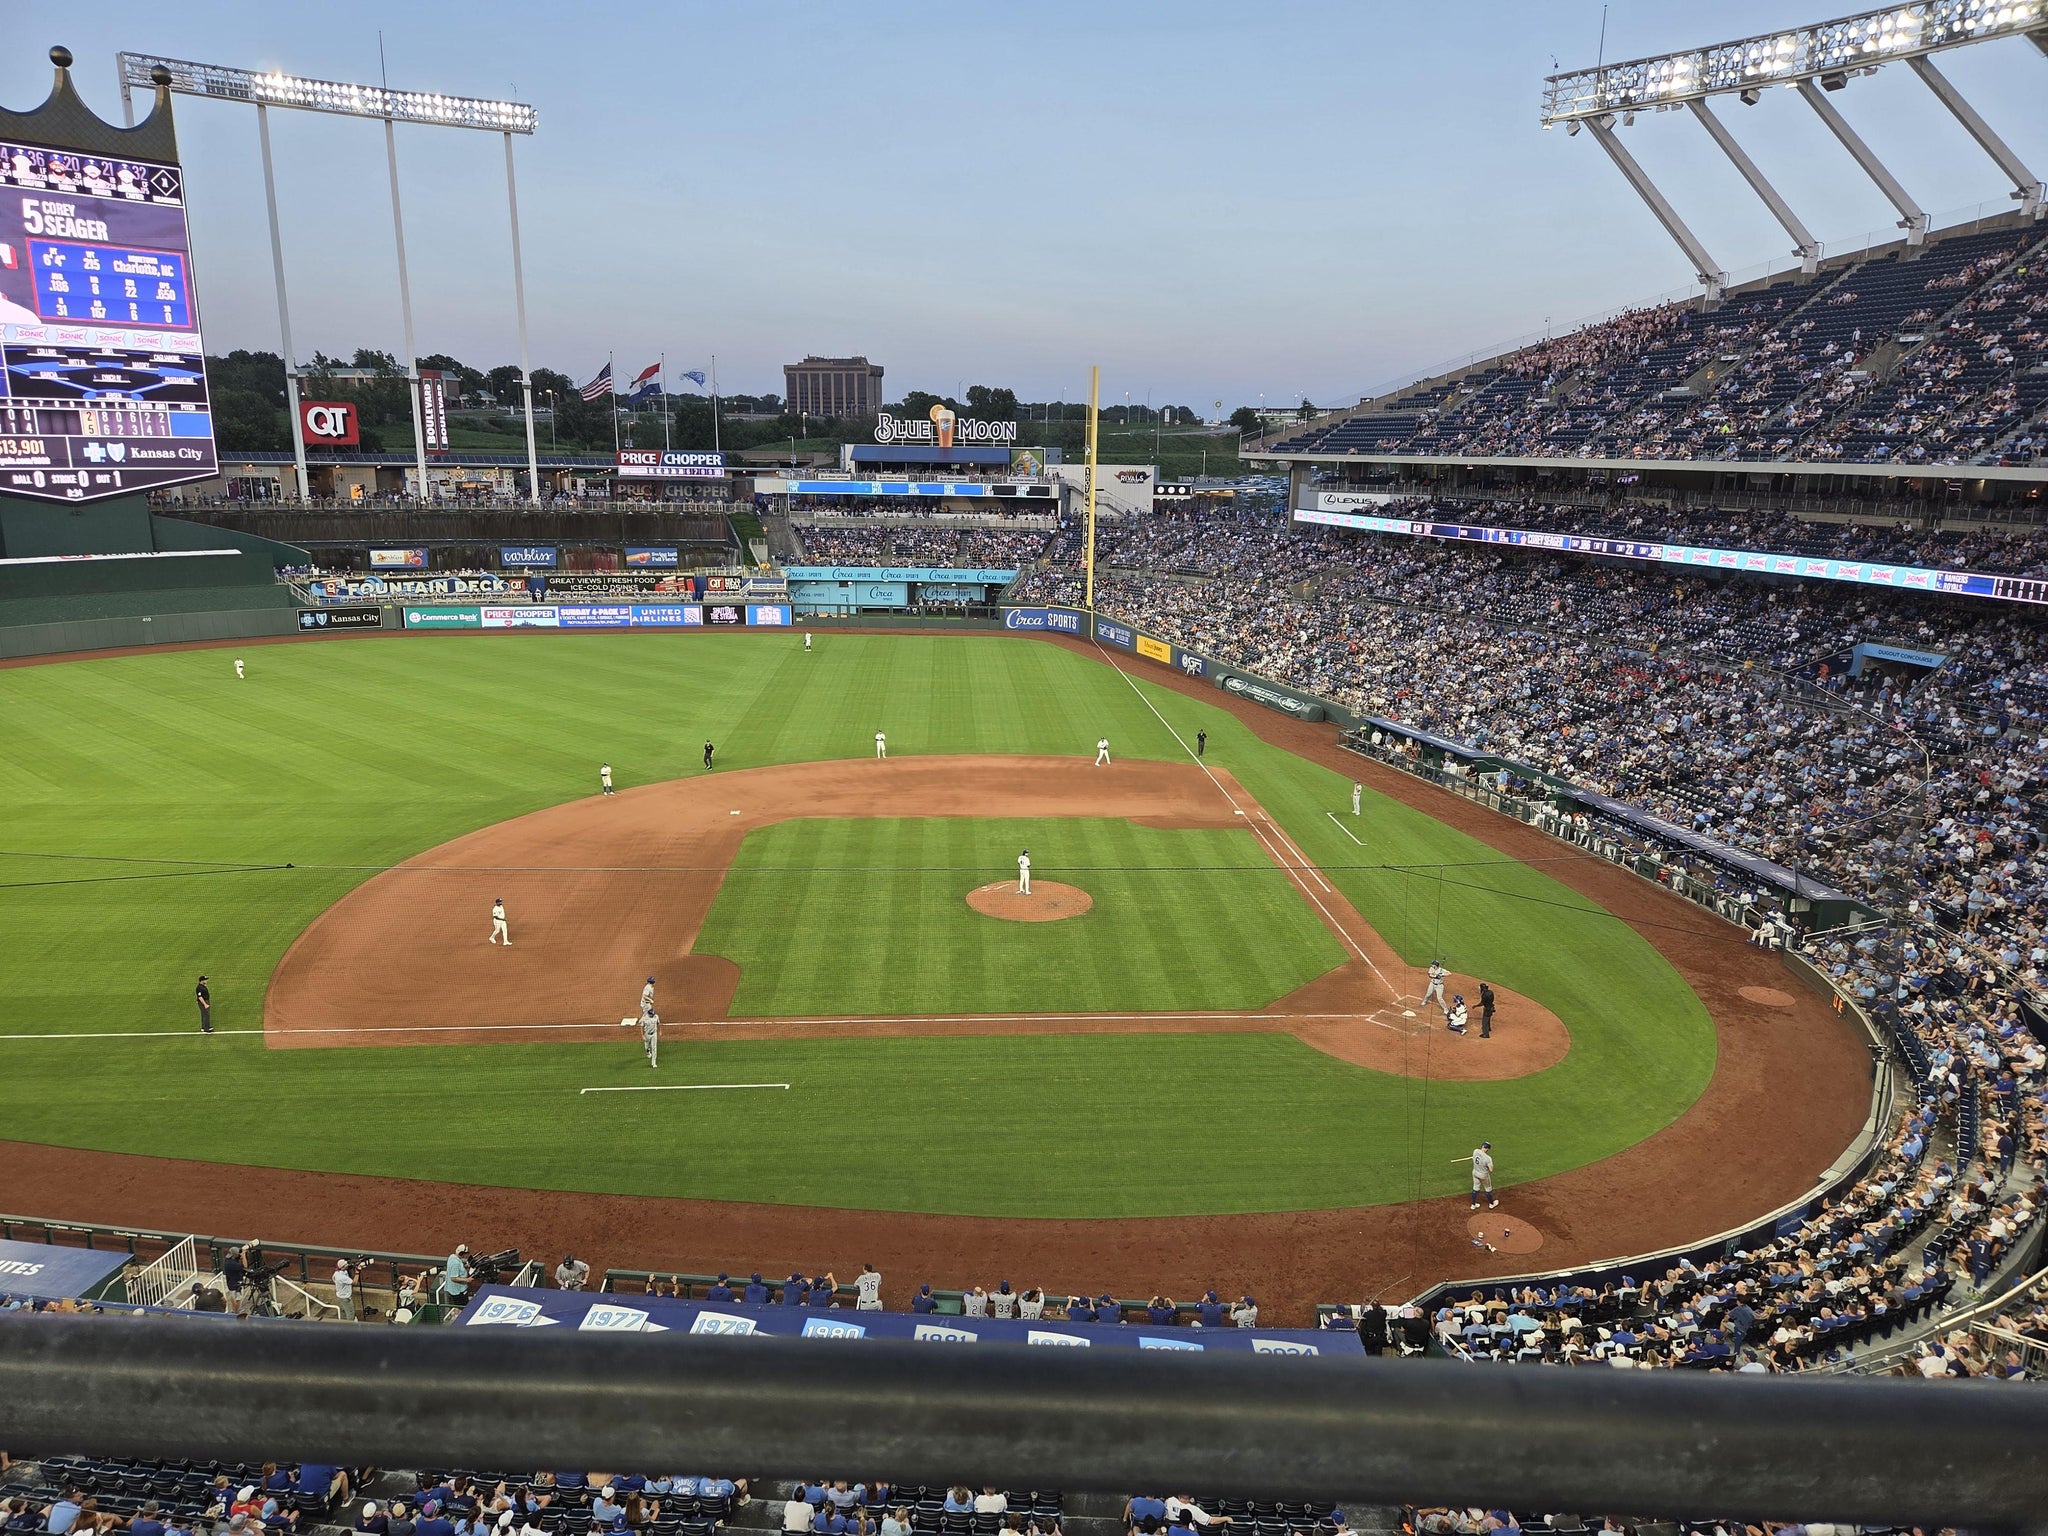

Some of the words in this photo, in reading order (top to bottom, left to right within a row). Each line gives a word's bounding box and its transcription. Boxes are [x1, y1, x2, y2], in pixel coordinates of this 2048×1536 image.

[28, 150, 45, 167] 36
[64, 156, 80, 172] 20
[101, 161, 114, 177] 21
[132, 165, 147, 181] 32
[42, 200, 75, 217] COREY
[22, 198, 44, 234] 5
[43, 214, 109, 241] SEAGER
[113, 260, 160, 277] Charlotte,
[160, 264, 174, 277] NC
[125, 286, 138, 298] 22
[56, 304, 68, 316] 31
[18, 329, 44, 338] SONIC
[59, 332, 84, 341] SONIC
[99, 335, 122, 343] SONIC
[137, 337, 159, 345] SONIC
[173, 339, 195, 347] SONIC
[8, 409, 15, 421] 0
[24, 409, 31, 421] 0
[86, 411, 92, 422] 2
[102, 411, 109, 422] 8
[116, 412, 122, 423] 0
[130, 411, 137, 423] 6
[145, 412, 152, 423] 2
[158, 412, 165, 424] 2
[423, 383, 437, 444] BOULEVARD
[436, 384, 448, 445] BOULEVARD
[306, 405, 348, 438] QT
[10, 423, 16, 434] 1
[25, 423, 33, 434] 4
[88, 424, 95, 434] 5
[103, 424, 110, 435] 6
[117, 424, 124, 436] 2
[131, 425, 138, 436] 3
[146, 425, 153, 436] 4
[160, 425, 166, 436] 1
[874, 413, 931, 443] BLUE
[959, 418, 1017, 441] MOON
[0, 439, 45, 456] 13,901
[131, 447, 176, 459] Kansas
[178, 448, 203, 461] City
[620, 452, 657, 464] PRICE
[663, 453, 722, 466] CHOPPER
[12, 474, 33, 485] BALL
[33, 470, 46, 488] 0
[51, 474, 77, 484] STRIKE
[77, 470, 90, 488] 0
[96, 474, 111, 484] OUT
[113, 470, 122, 487] 1
[1120, 474, 1144, 482] RIVALS
[617, 484, 653, 496] PRIC
[1337, 497, 1373, 505] LEXUS
[1513, 533, 1517, 544] 5
[1527, 534, 1543, 545] COREY
[1543, 536, 1563, 547] SEAGER
[503, 548, 553, 561] carbliss
[1625, 544, 1634, 555] 22
[1694, 553, 1709, 561] SONIC
[1748, 558, 1765, 566] SONIC
[1778, 561, 1795, 569] SONIC
[785, 568, 804, 578] Circa
[832, 568, 853, 579] Circa
[880, 569, 902, 579] Circa
[929, 569, 950, 581] Circa
[976, 570, 997, 581] Circa
[1840, 568, 1858, 576] SONIC
[1873, 571, 1891, 580] SONIC
[709, 579, 722, 589] QT
[1907, 575, 1927, 583] SONIC
[1944, 574, 1969, 584] RANGERS
[1998, 579, 2003, 588] 0
[2020, 581, 2025, 590] 0
[2041, 584, 2046, 593] 0
[347, 580, 449, 597] FOUNTAIN
[455, 580, 506, 593] DECK
[510, 581, 523, 590] QT
[924, 585, 951, 598] Circa
[955, 590, 972, 598] SPORTS
[1943, 582, 1963, 592] ROYALS
[1997, 587, 2002, 596] 0
[2007, 589, 2012, 598] 0
[2018, 590, 2023, 598] 0
[2028, 591, 2034, 600] 0
[793, 588, 811, 598] Circa
[869, 585, 894, 599] Circa
[331, 614, 361, 623] Kansas
[362, 613, 380, 623] City
[459, 613, 478, 621] Bank
[560, 608, 591, 616] SUNDAY
[641, 608, 681, 616] UNITED
[1006, 609, 1044, 629] Circa
[1047, 613, 1078, 630] SPORTS
[1878, 649, 1900, 657] DUGOUT
[1900, 653, 1933, 664] CONCOURSE
[1978, 1244, 1985, 1254] 7
[864, 1281, 876, 1292] 36
[479, 1302, 537, 1320] 1976
[972, 1304, 982, 1315] 21
[998, 1303, 1010, 1314] 33
[586, 1311, 644, 1328] 1977
[1023, 1311, 1035, 1320] 20
[694, 1318, 751, 1335] 1978
[806, 1326, 861, 1340] 1980
[704, 1486, 715, 1494] WITT
